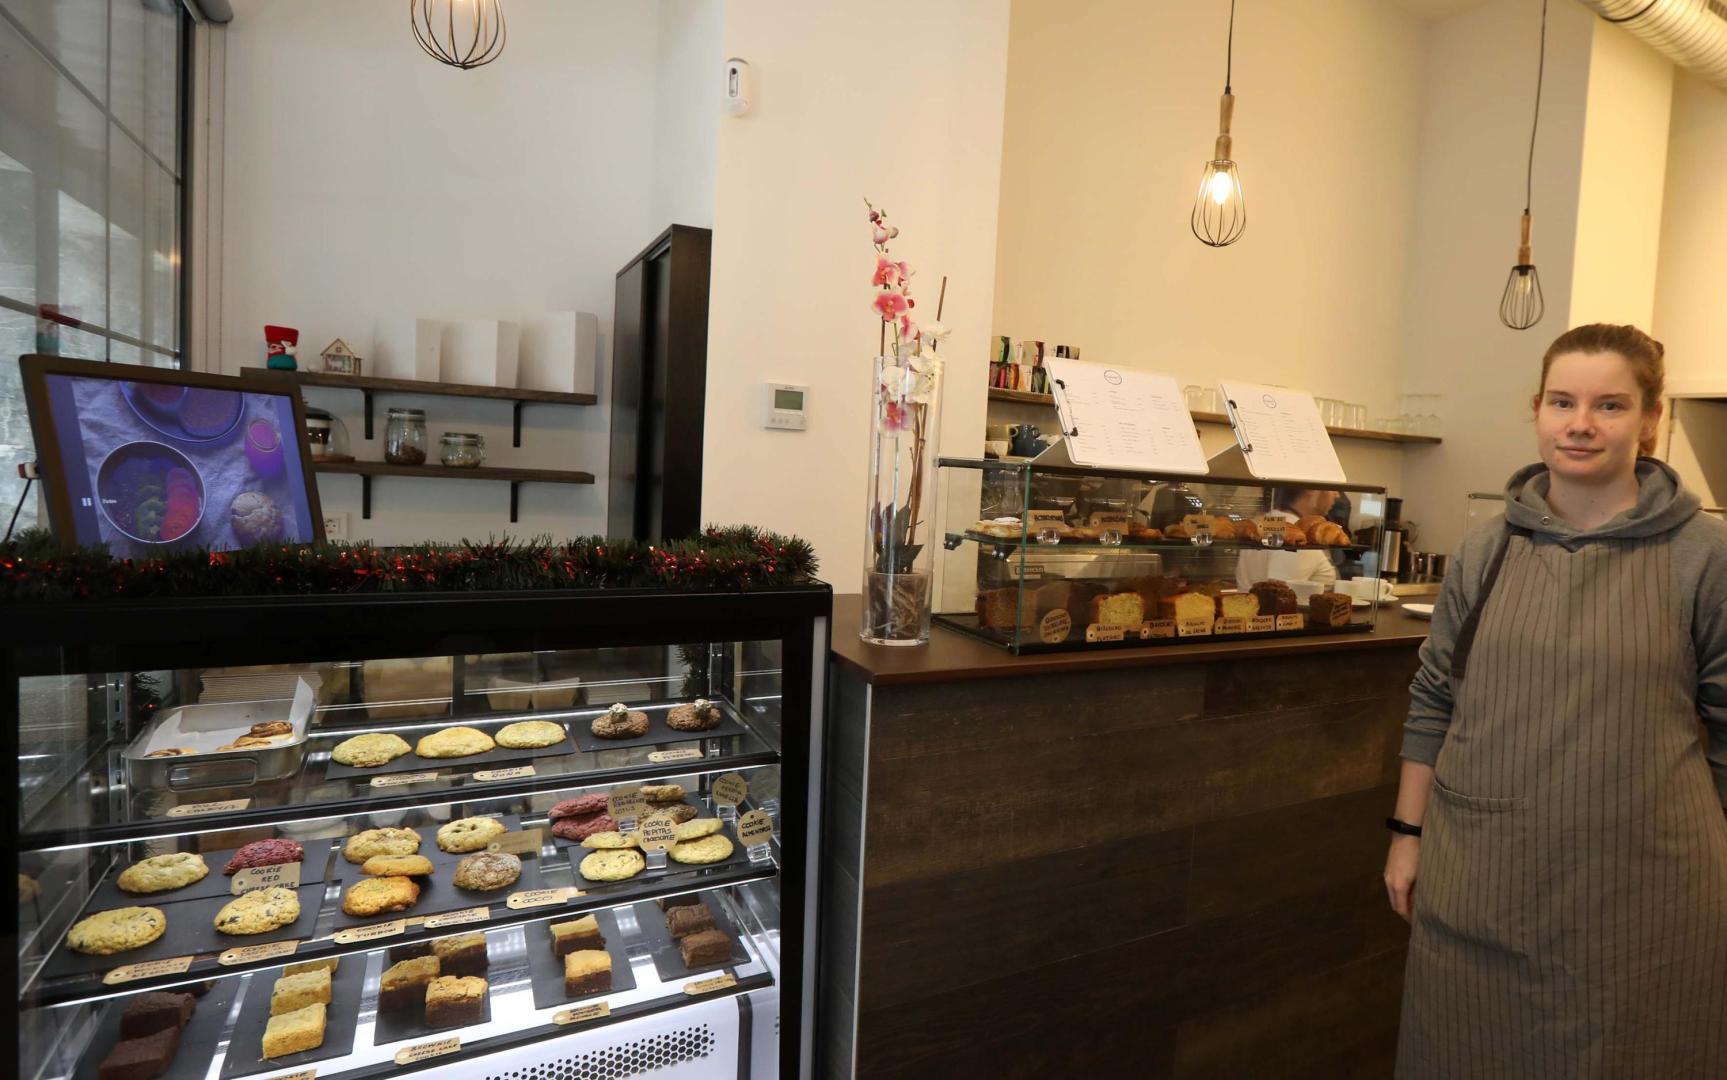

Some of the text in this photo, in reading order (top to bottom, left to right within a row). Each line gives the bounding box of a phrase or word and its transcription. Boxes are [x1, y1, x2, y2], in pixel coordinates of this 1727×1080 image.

[643, 820, 671, 829] COOKIE
[741, 818, 766, 829] COOKIE
[643, 828, 672, 837] PEPITAS
[643, 835, 675, 843] CHOCOLATE
[250, 865, 282, 875] COOKIE
[261, 874, 280, 882] RED
[524, 889, 558, 897] COOKIE
[410, 1039, 452, 1051] BROWNIE
